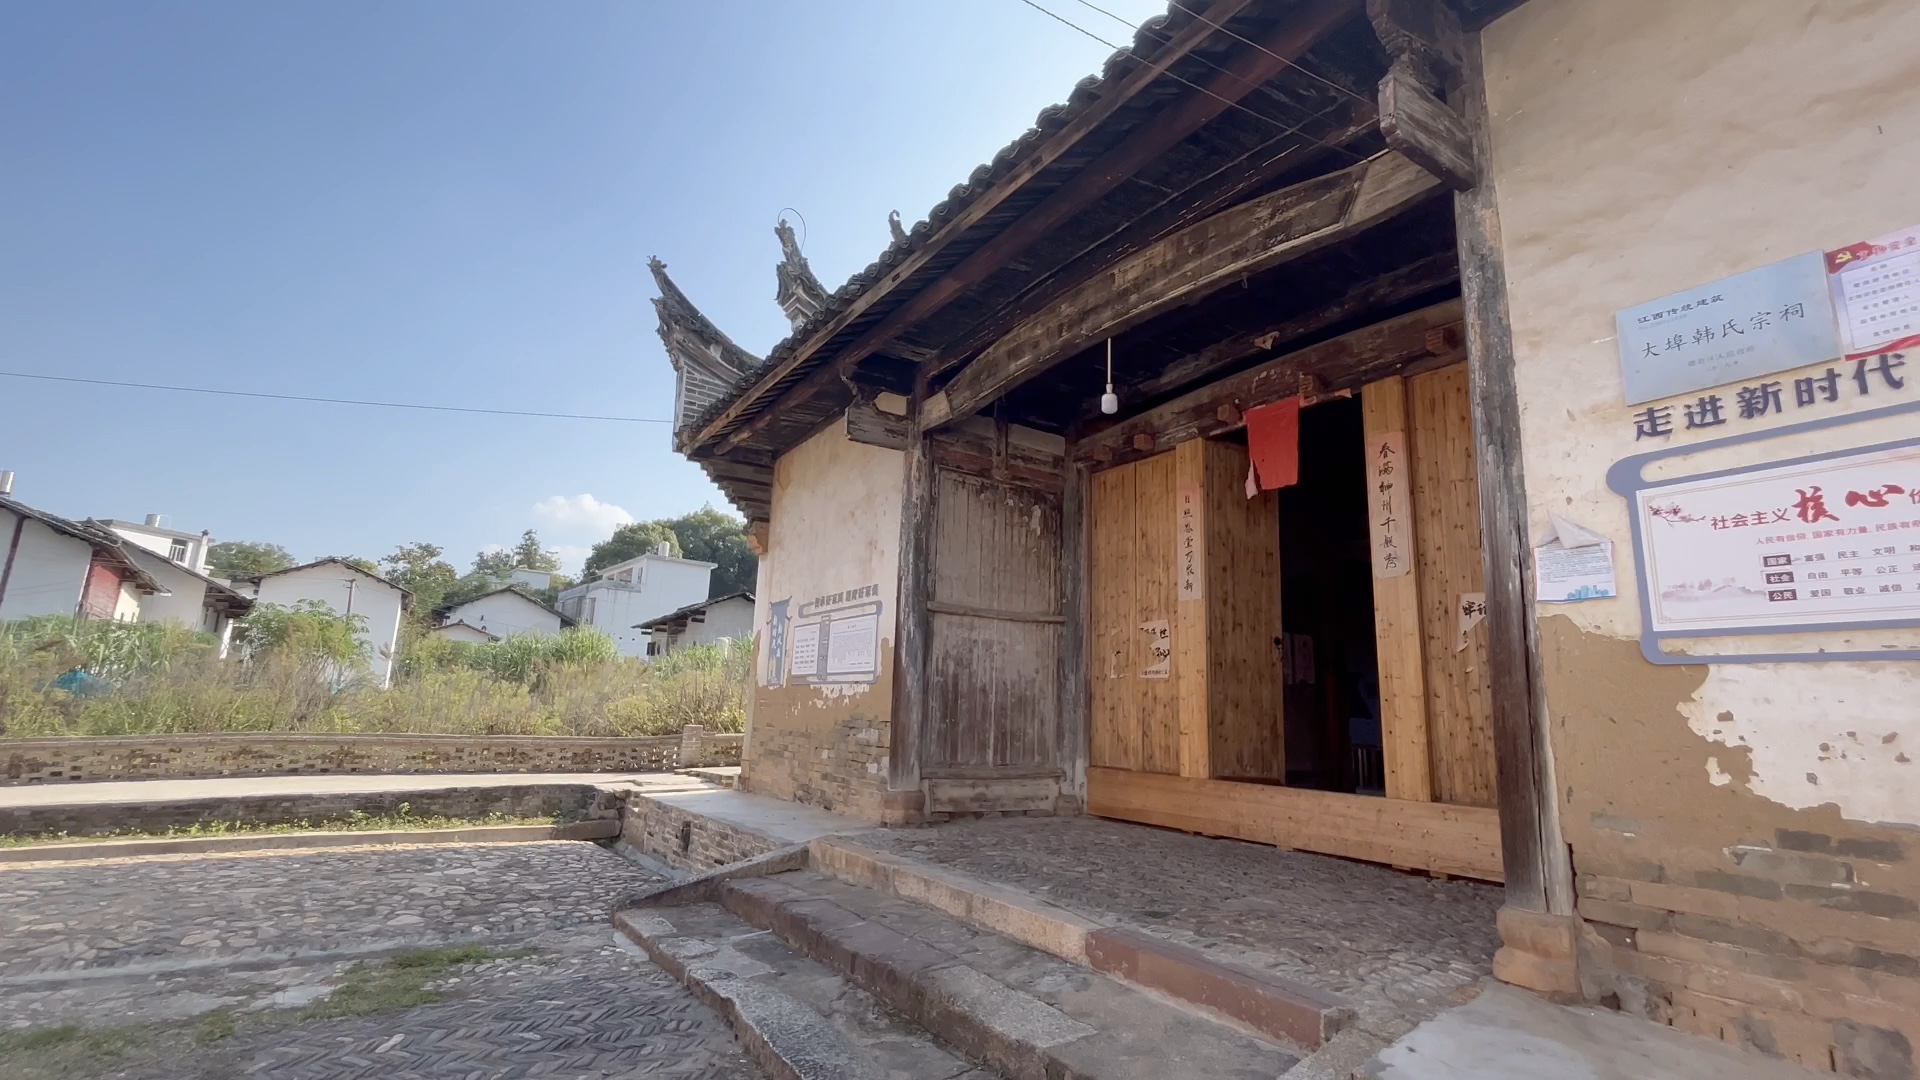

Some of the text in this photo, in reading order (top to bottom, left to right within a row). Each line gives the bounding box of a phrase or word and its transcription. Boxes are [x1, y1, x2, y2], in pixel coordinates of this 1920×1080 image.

[1637, 294, 1725, 324] 江西传统建筑
[1642, 302, 1805, 360] 大埠韩氏宗祠
[1633, 353, 1906, 442] 走进新时代
[1766, 556, 1789, 567] 国家
[1804, 552, 1826, 562] 富强
[1837, 550, 1859, 559] 民主
[1872, 546, 1896, 557] 文明
[1769, 574, 1792, 583] 社会
[1807, 571, 1829, 580] 自由
[1841, 568, 1863, 577] 平等
[1875, 564, 1899, 574] 公正
[1772, 584, 1903, 601] 公民 爱国 敬业 诚信
